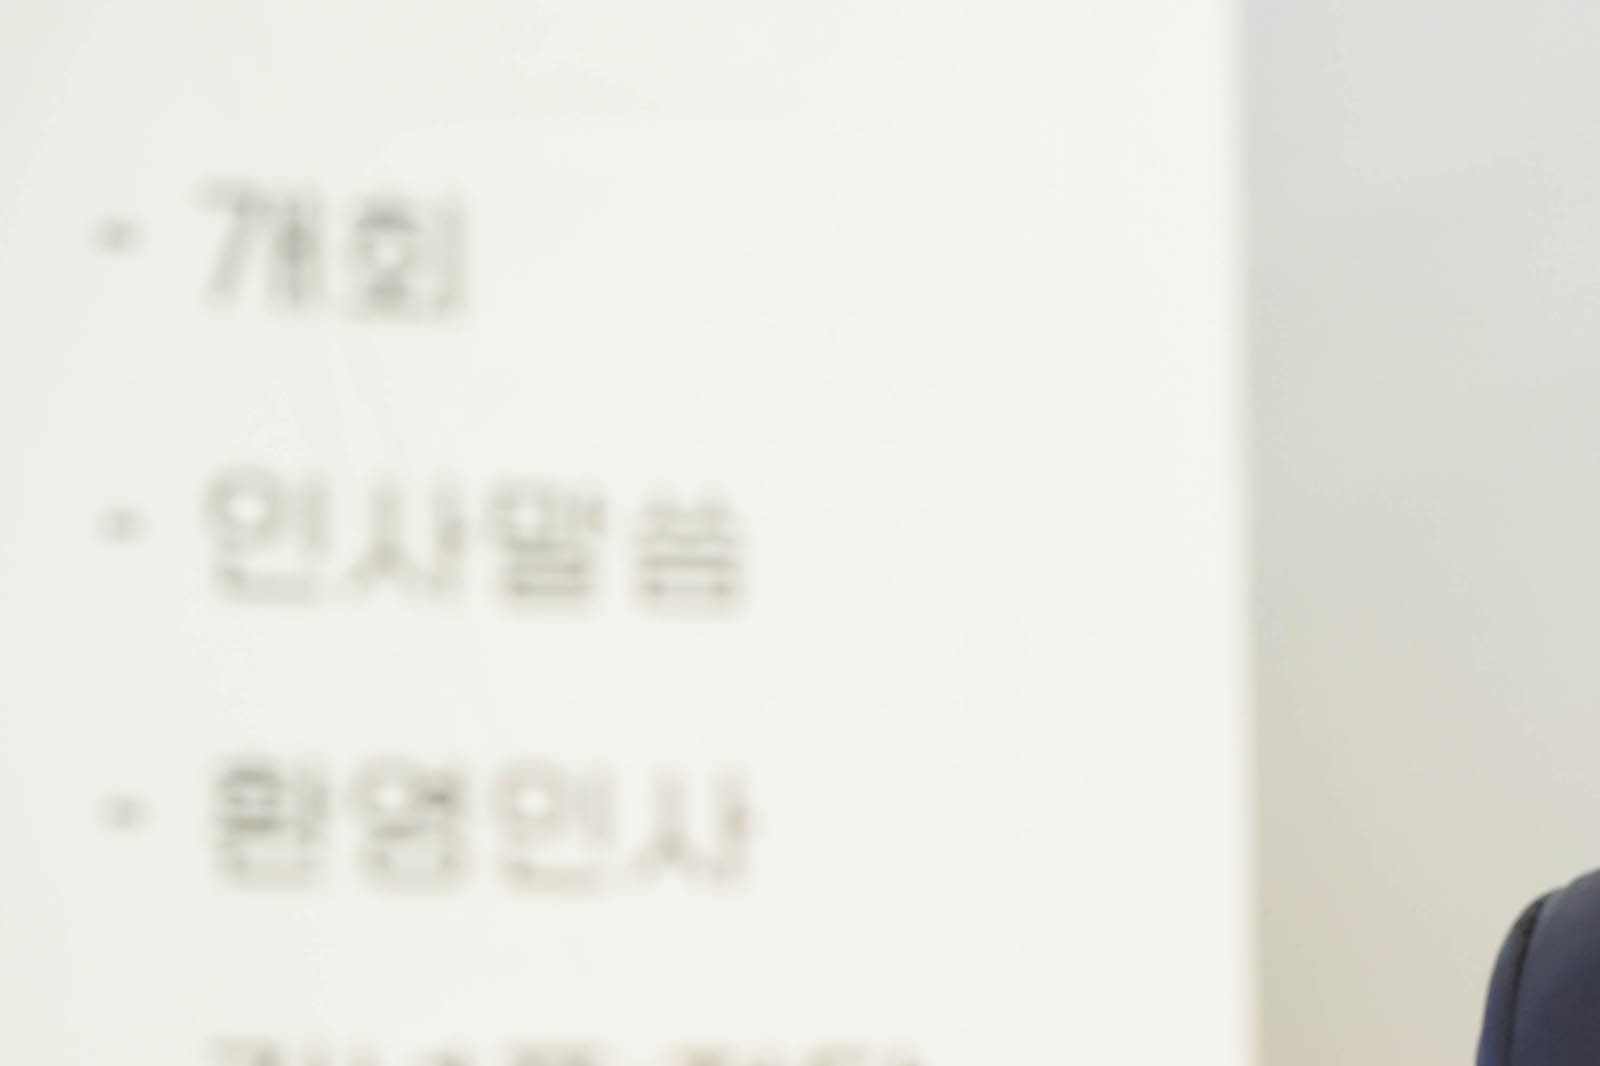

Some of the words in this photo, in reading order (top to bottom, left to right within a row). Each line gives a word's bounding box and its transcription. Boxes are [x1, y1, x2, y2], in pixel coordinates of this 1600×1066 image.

[195, 176, 468, 323] 개회
[197, 463, 748, 616] 인사말씀
[205, 750, 756, 896] 환영인사
